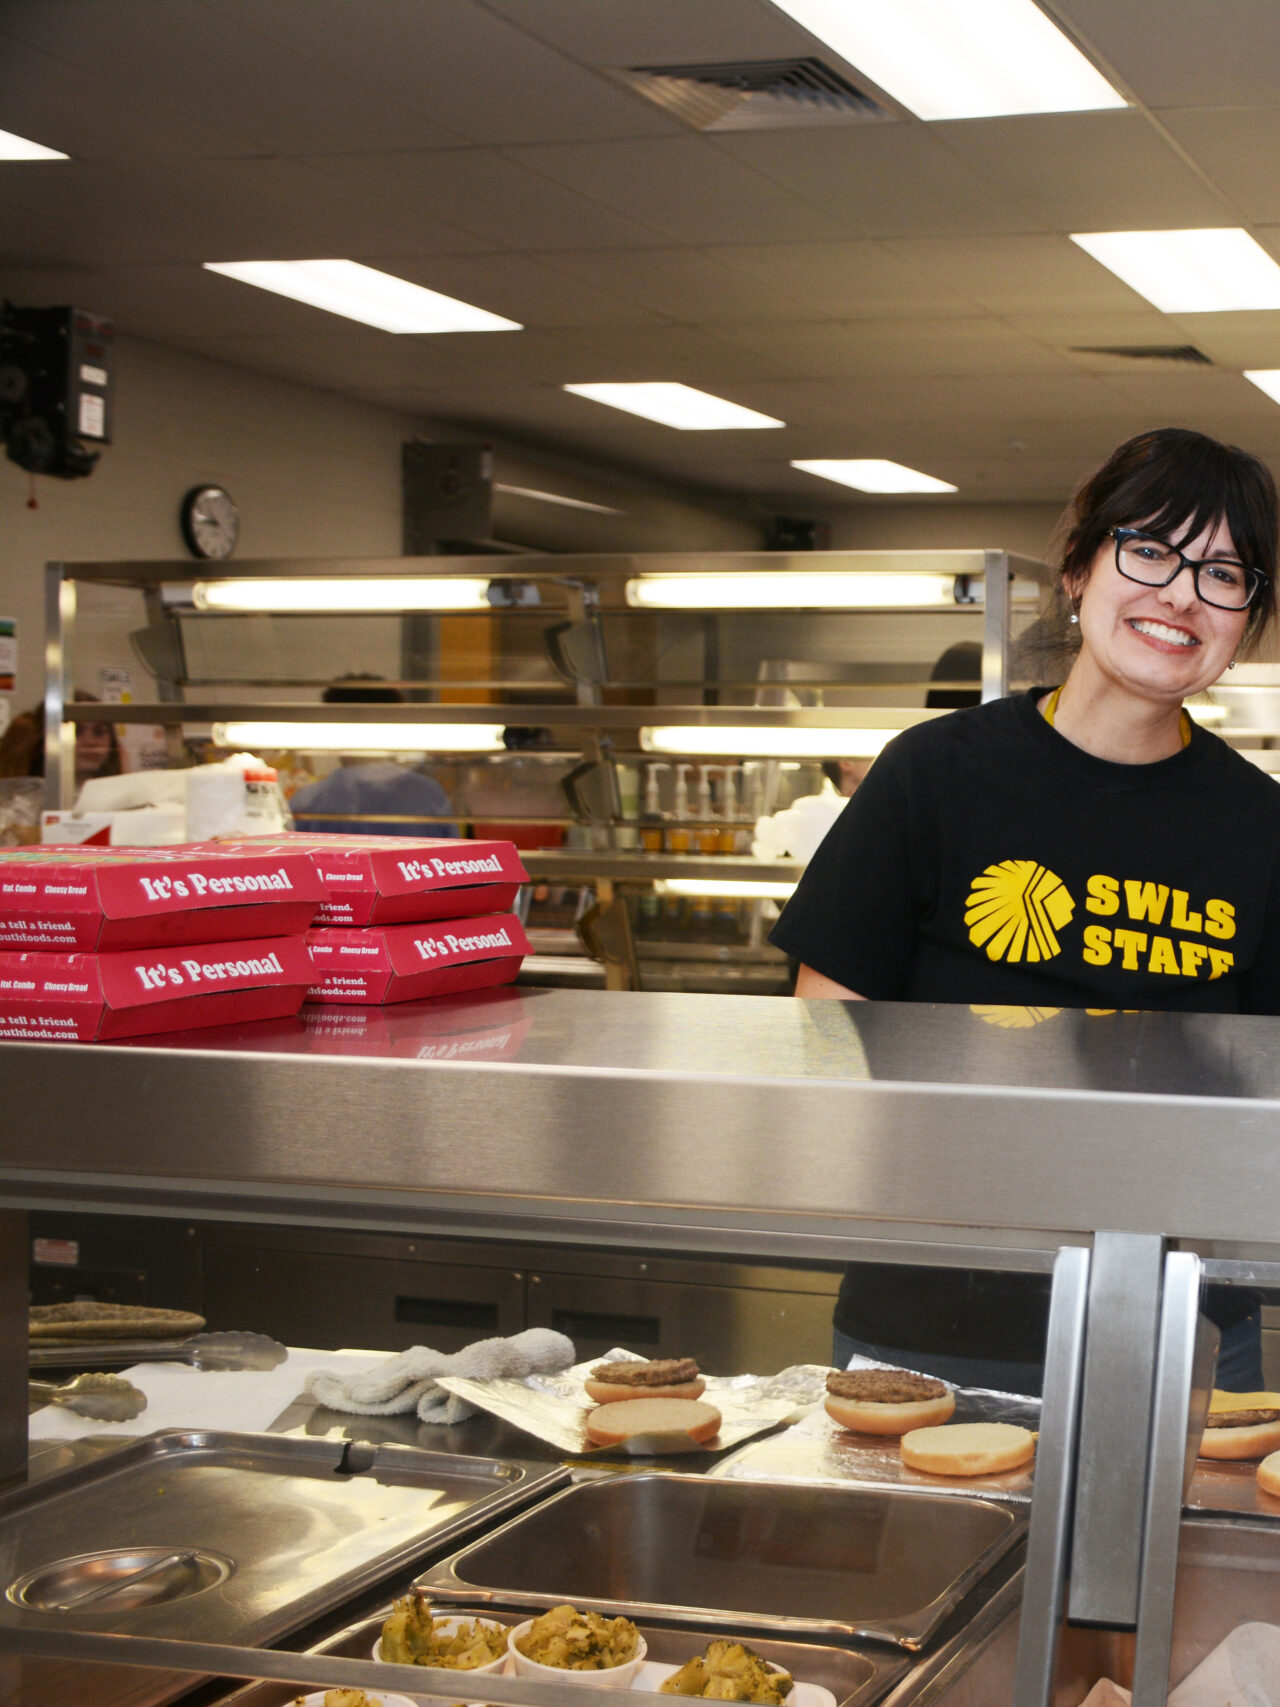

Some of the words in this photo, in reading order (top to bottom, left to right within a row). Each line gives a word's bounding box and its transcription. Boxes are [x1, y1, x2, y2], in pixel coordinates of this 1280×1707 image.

[397, 860, 434, 882] It's
[429, 854, 503, 876] Personal
[15, 884, 37, 894] Combo
[44, 885, 68, 895] Cheesy
[68, 885, 88, 895] Bread
[139, 876, 189, 901] It's
[187, 868, 294, 895] Personal
[320, 903, 354, 911] friend.
[1085, 874, 1237, 940] SWLS
[313, 914, 354, 922] ods.com
[8, 920, 28, 930] tell
[29, 922, 36, 930] a
[37, 921, 76, 931] friend.
[414, 937, 449, 959] It's
[444, 927, 513, 953] Personal
[1082, 924, 1234, 981] STAFF
[135, 963, 184, 989] It's
[181, 952, 284, 982] Personal
[13, 980, 36, 990] Combo
[44, 982, 68, 992] Cheesy
[68, 982, 89, 992] Bread
[325, 977, 331, 985] a
[332, 976, 367, 986] friend.
[8, 1016, 28, 1025] tell
[30, 1017, 37, 1026] a
[38, 1016, 78, 1027] friend.
